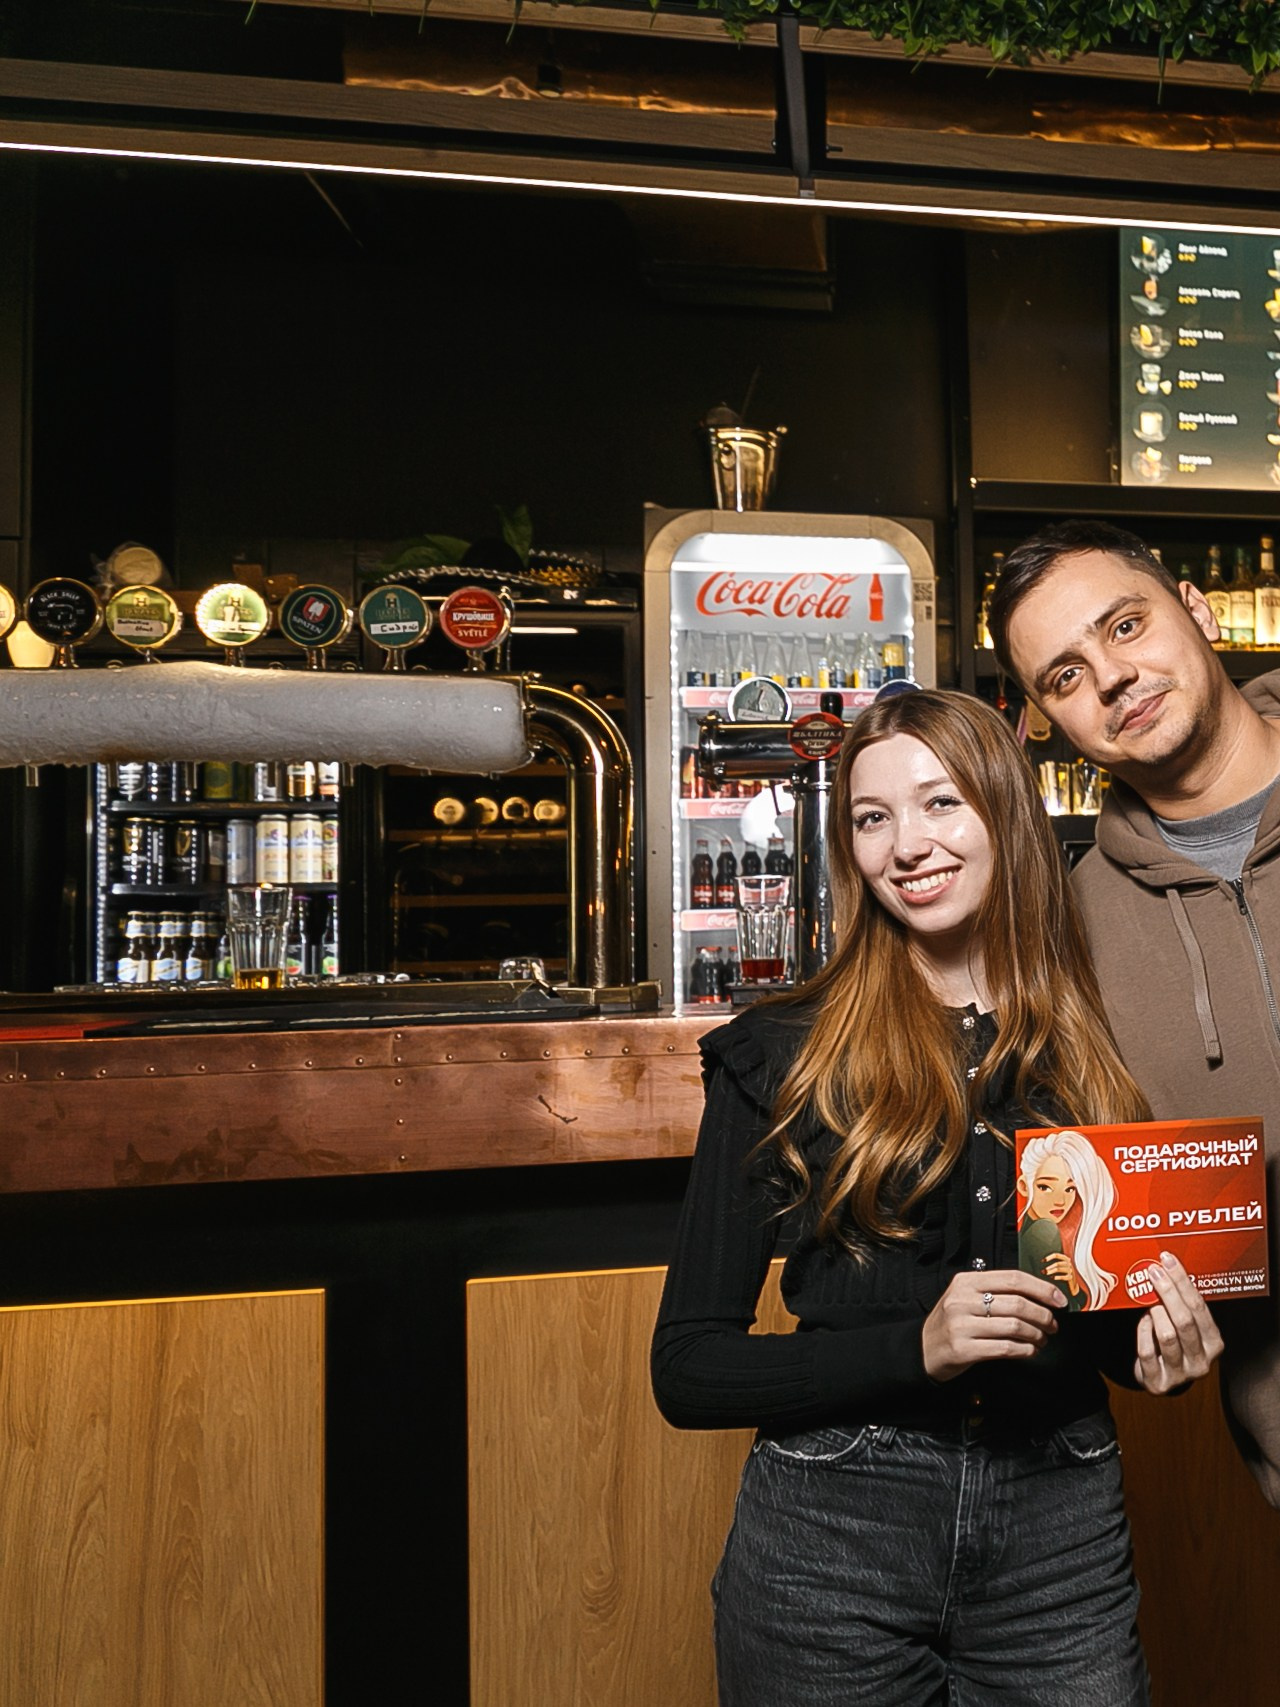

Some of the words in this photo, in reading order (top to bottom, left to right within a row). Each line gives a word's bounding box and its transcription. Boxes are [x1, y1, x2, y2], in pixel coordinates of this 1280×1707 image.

[696, 572, 861, 618] Coca-Cola
[292, 615, 322, 635] SPATEN
[1114, 1135, 1258, 1160] ПОДАРОЧНЫЙ
[1121, 1152, 1253, 1174] СЕРТИФИКАТ
[1108, 1216, 1161, 1232] 1000
[1168, 1202, 1262, 1227] РУБЛЕЙ
[1244, 1274, 1265, 1284] WAY
